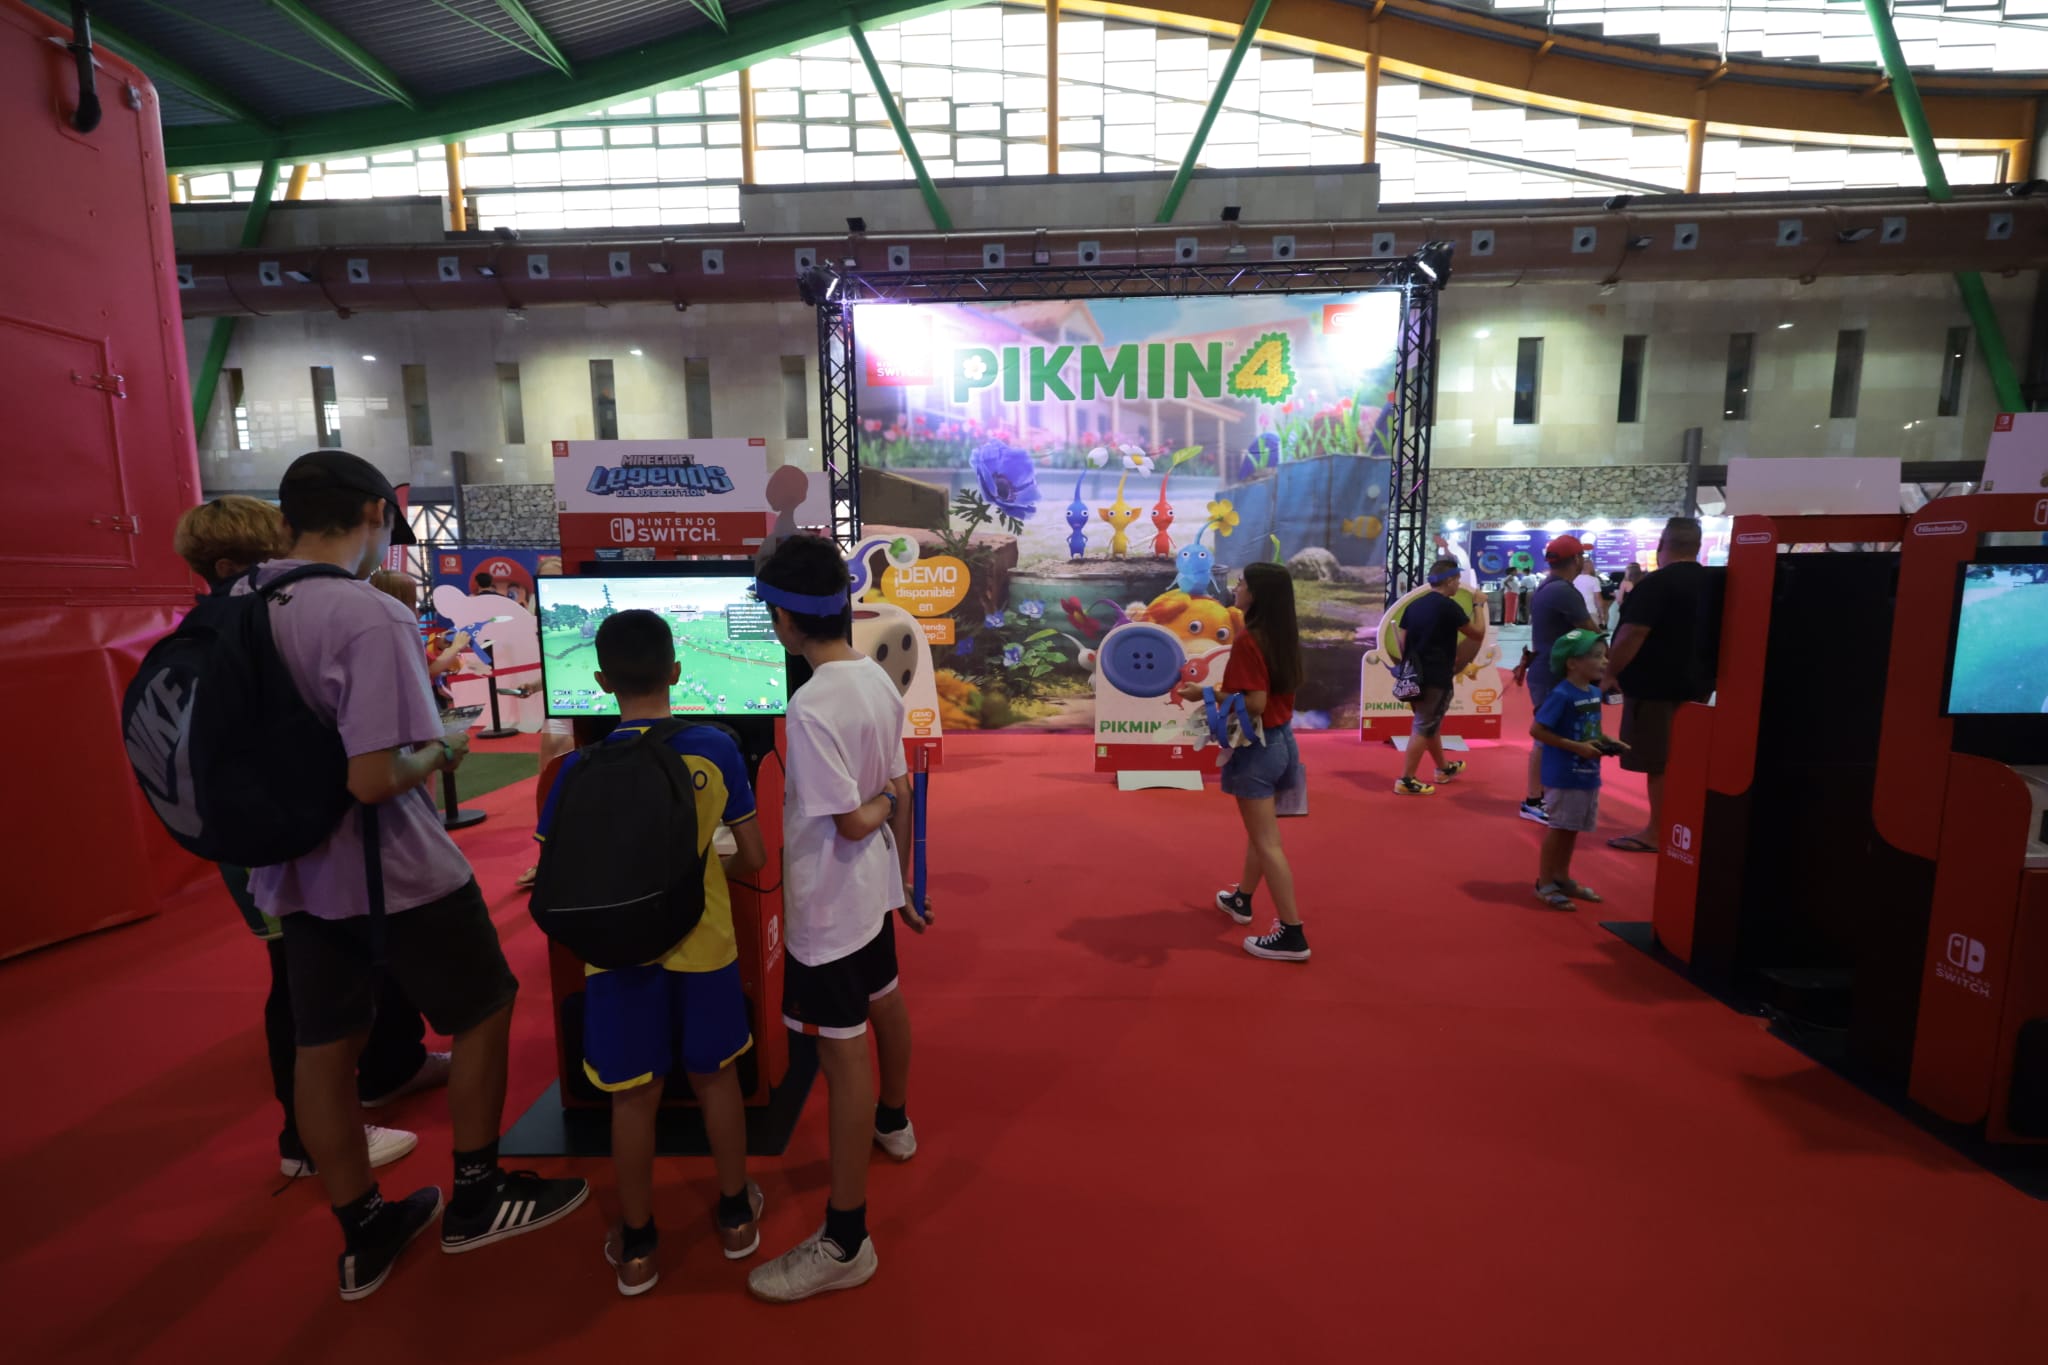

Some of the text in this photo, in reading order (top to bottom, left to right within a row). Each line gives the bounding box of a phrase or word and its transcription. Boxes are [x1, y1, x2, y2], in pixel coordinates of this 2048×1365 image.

[953, 336, 1293, 403] PIKMIN 4
[621, 454, 694, 467] MINECRAFT
[637, 517, 716, 526] NINTENDO
[638, 527, 717, 542] SWITCH
[895, 566, 957, 588] ¡DEMO
[895, 586, 956, 600] disponible!
[918, 602, 934, 612] en
[1364, 702, 1404, 711] PIKMIN
[125, 667, 187, 799] NIKE
[1099, 720, 1162, 734] PIKMIN
